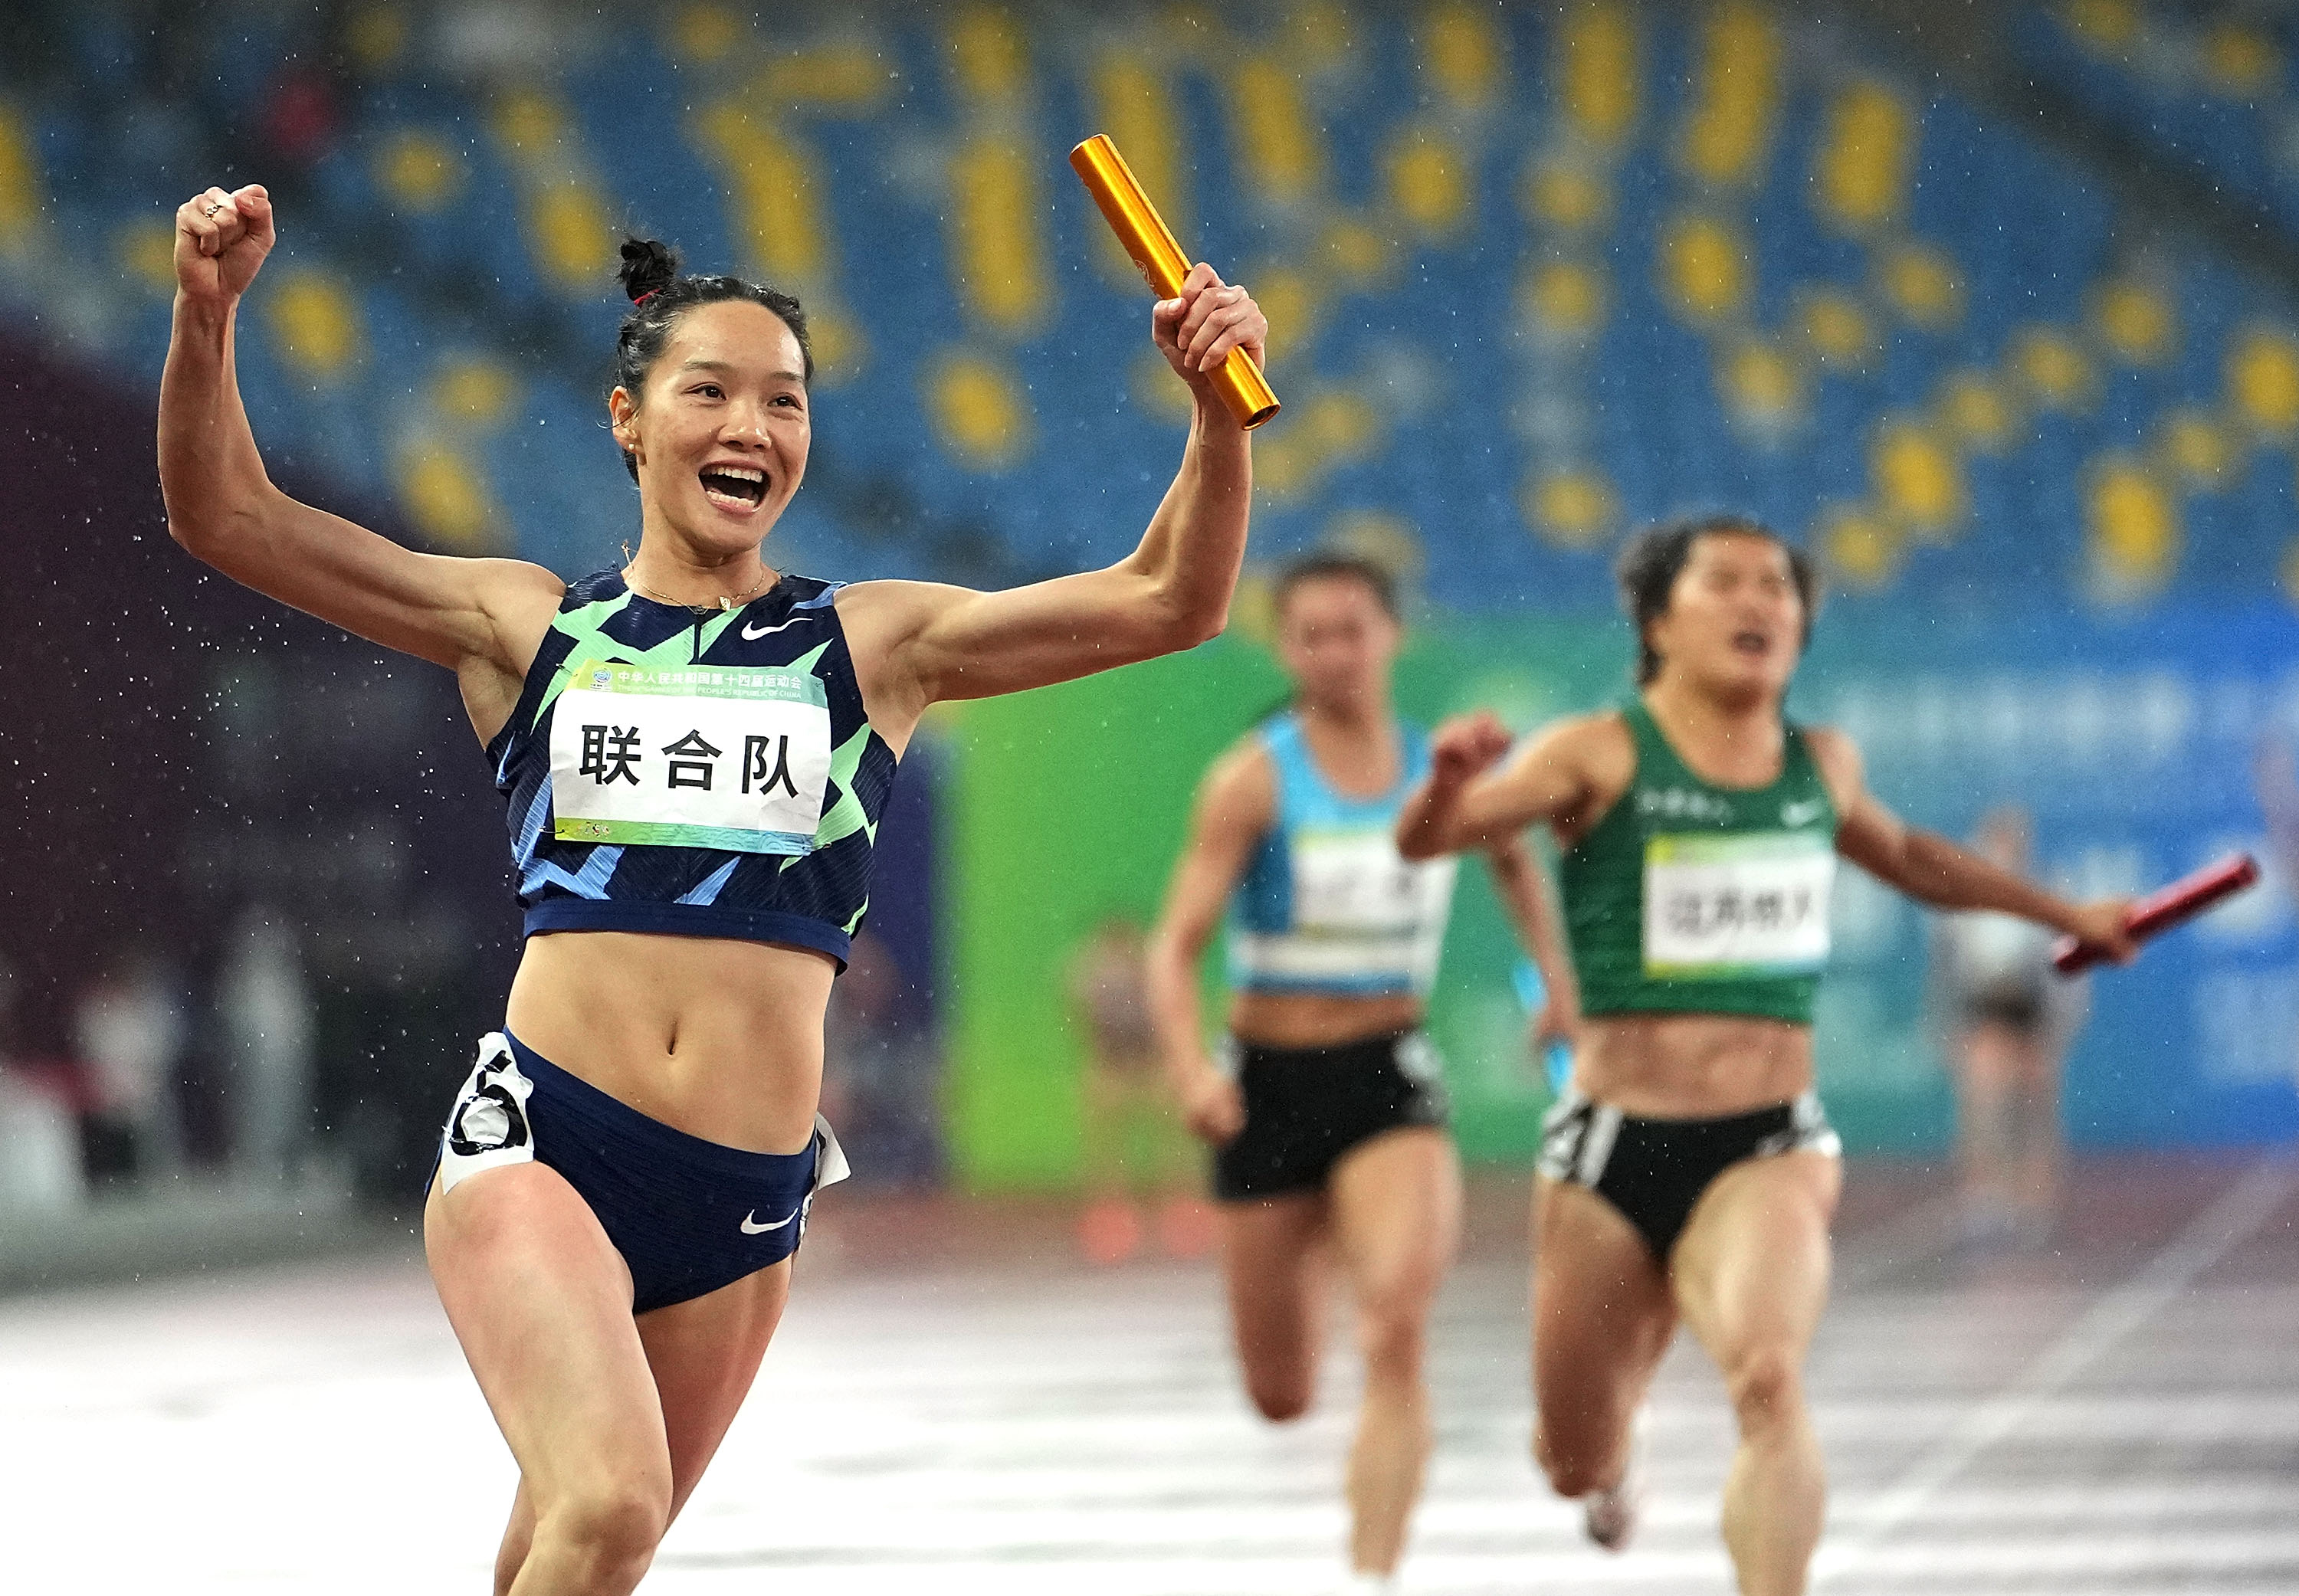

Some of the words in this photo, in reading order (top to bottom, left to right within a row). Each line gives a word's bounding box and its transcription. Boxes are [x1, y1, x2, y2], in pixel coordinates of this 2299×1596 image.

[618, 671, 802, 689] 中华人民共和国第十四届运动会
[779, 690, 802, 700] CHINA
[579, 725, 799, 798] 联合队
